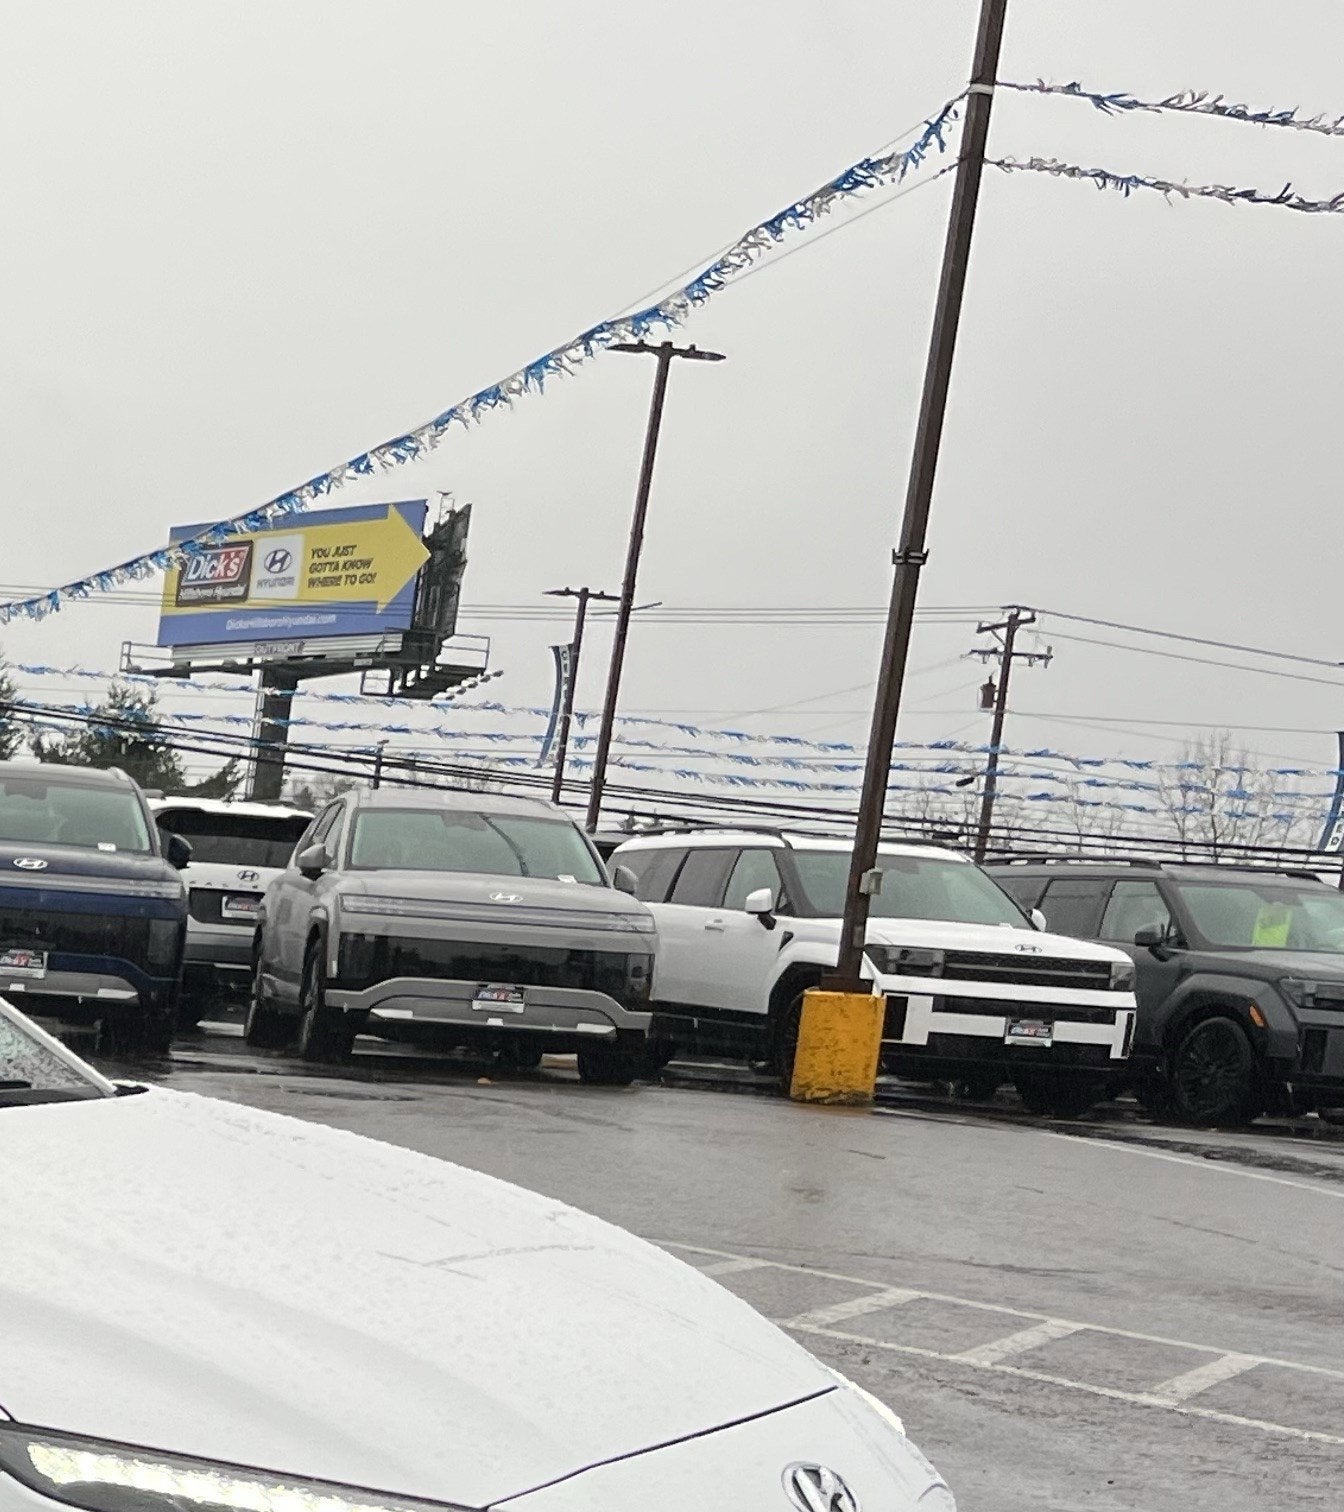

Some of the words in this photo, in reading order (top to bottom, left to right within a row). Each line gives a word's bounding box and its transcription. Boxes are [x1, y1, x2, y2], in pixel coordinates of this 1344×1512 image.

[311, 547, 330, 559] YOU
[332, 544, 357, 558] JUST
[308, 560, 340, 574] GOTTA
[341, 558, 374, 571] KNOW
[307, 575, 343, 588] WHERE
[344, 574, 358, 586] TO
